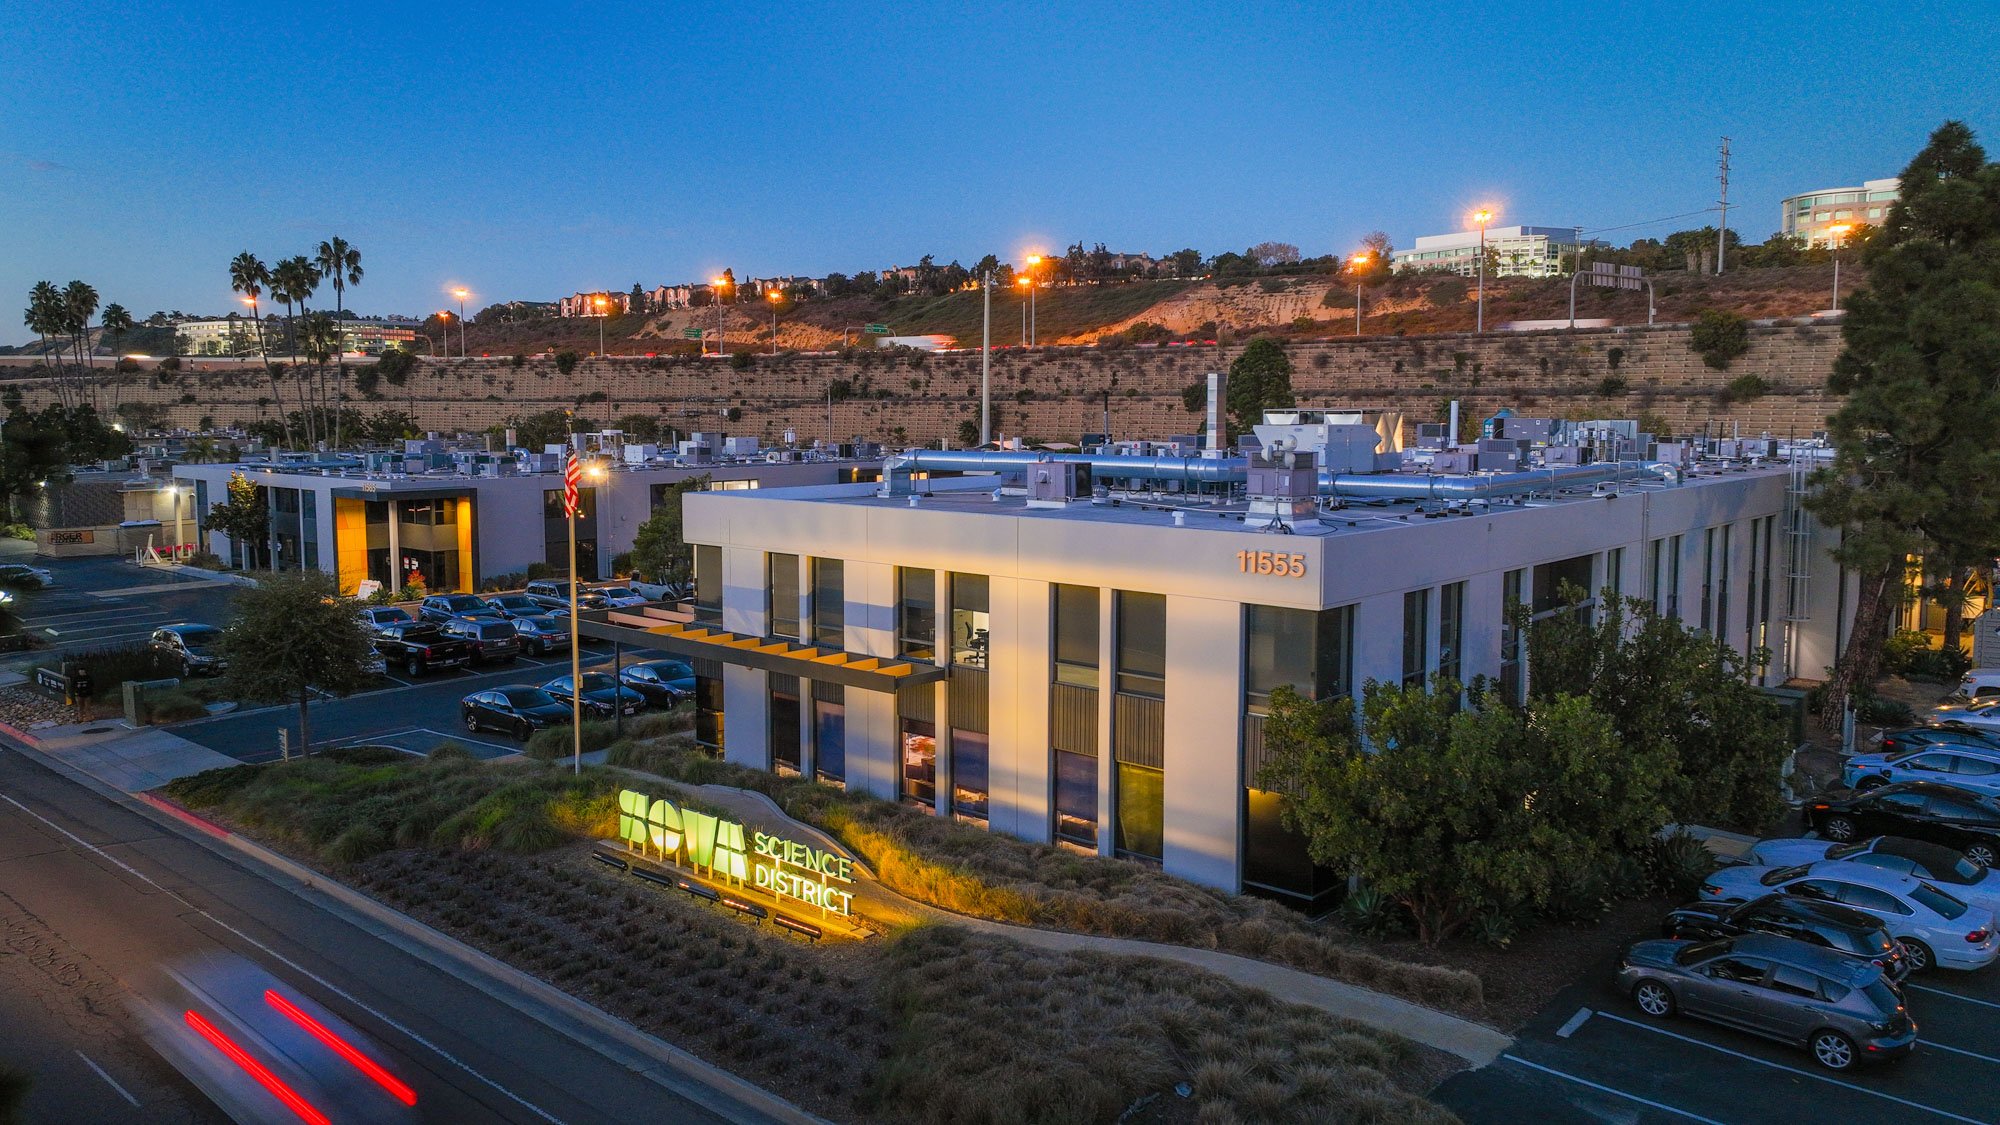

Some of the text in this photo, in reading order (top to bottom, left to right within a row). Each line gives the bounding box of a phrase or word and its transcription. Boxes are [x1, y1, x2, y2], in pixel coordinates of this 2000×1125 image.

[1236, 550, 1306, 578] 11555
[754, 831, 855, 884] SCIENCE
[755, 863, 856, 916] DISTRICT
